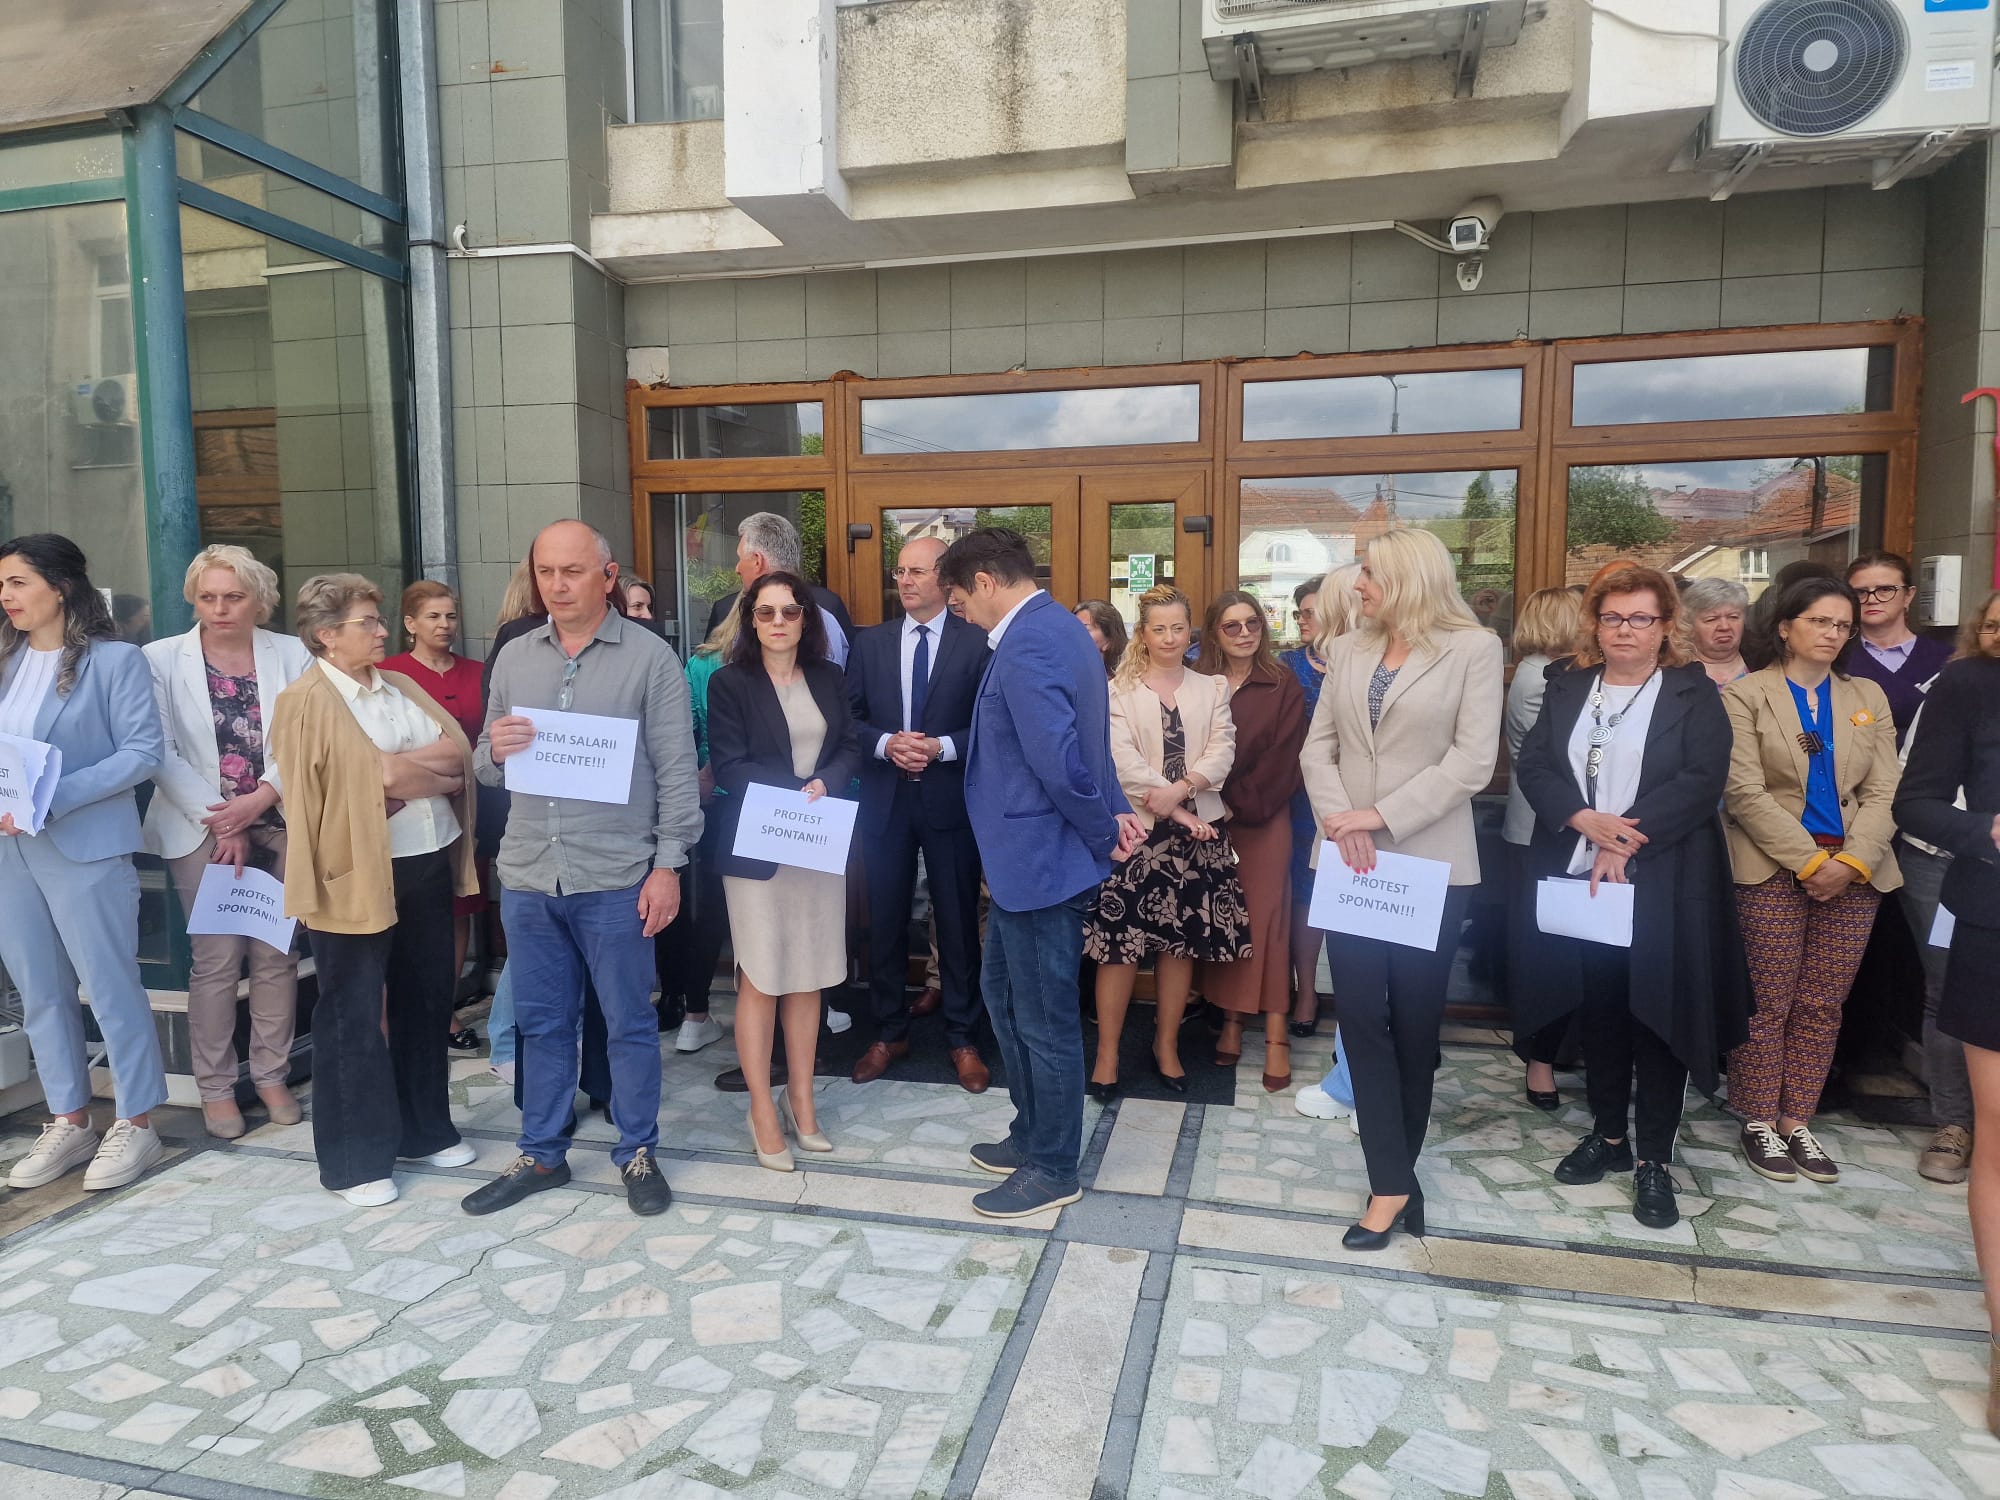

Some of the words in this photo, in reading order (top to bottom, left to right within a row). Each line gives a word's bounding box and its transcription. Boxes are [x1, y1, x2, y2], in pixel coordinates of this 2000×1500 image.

[537, 731, 566, 744] REM
[570, 735, 617, 750] SALARII
[535, 751, 606, 768] DECENTE!!!
[773, 808, 824, 825] PROTEST
[761, 824, 828, 846] SPONTAN!!!
[1352, 874, 1409, 895] PROTEST
[230, 887, 276, 907] PROTEST
[1338, 893, 1415, 918] SPONTAN!!!
[216, 903, 278, 926] SPONTAN!!!
